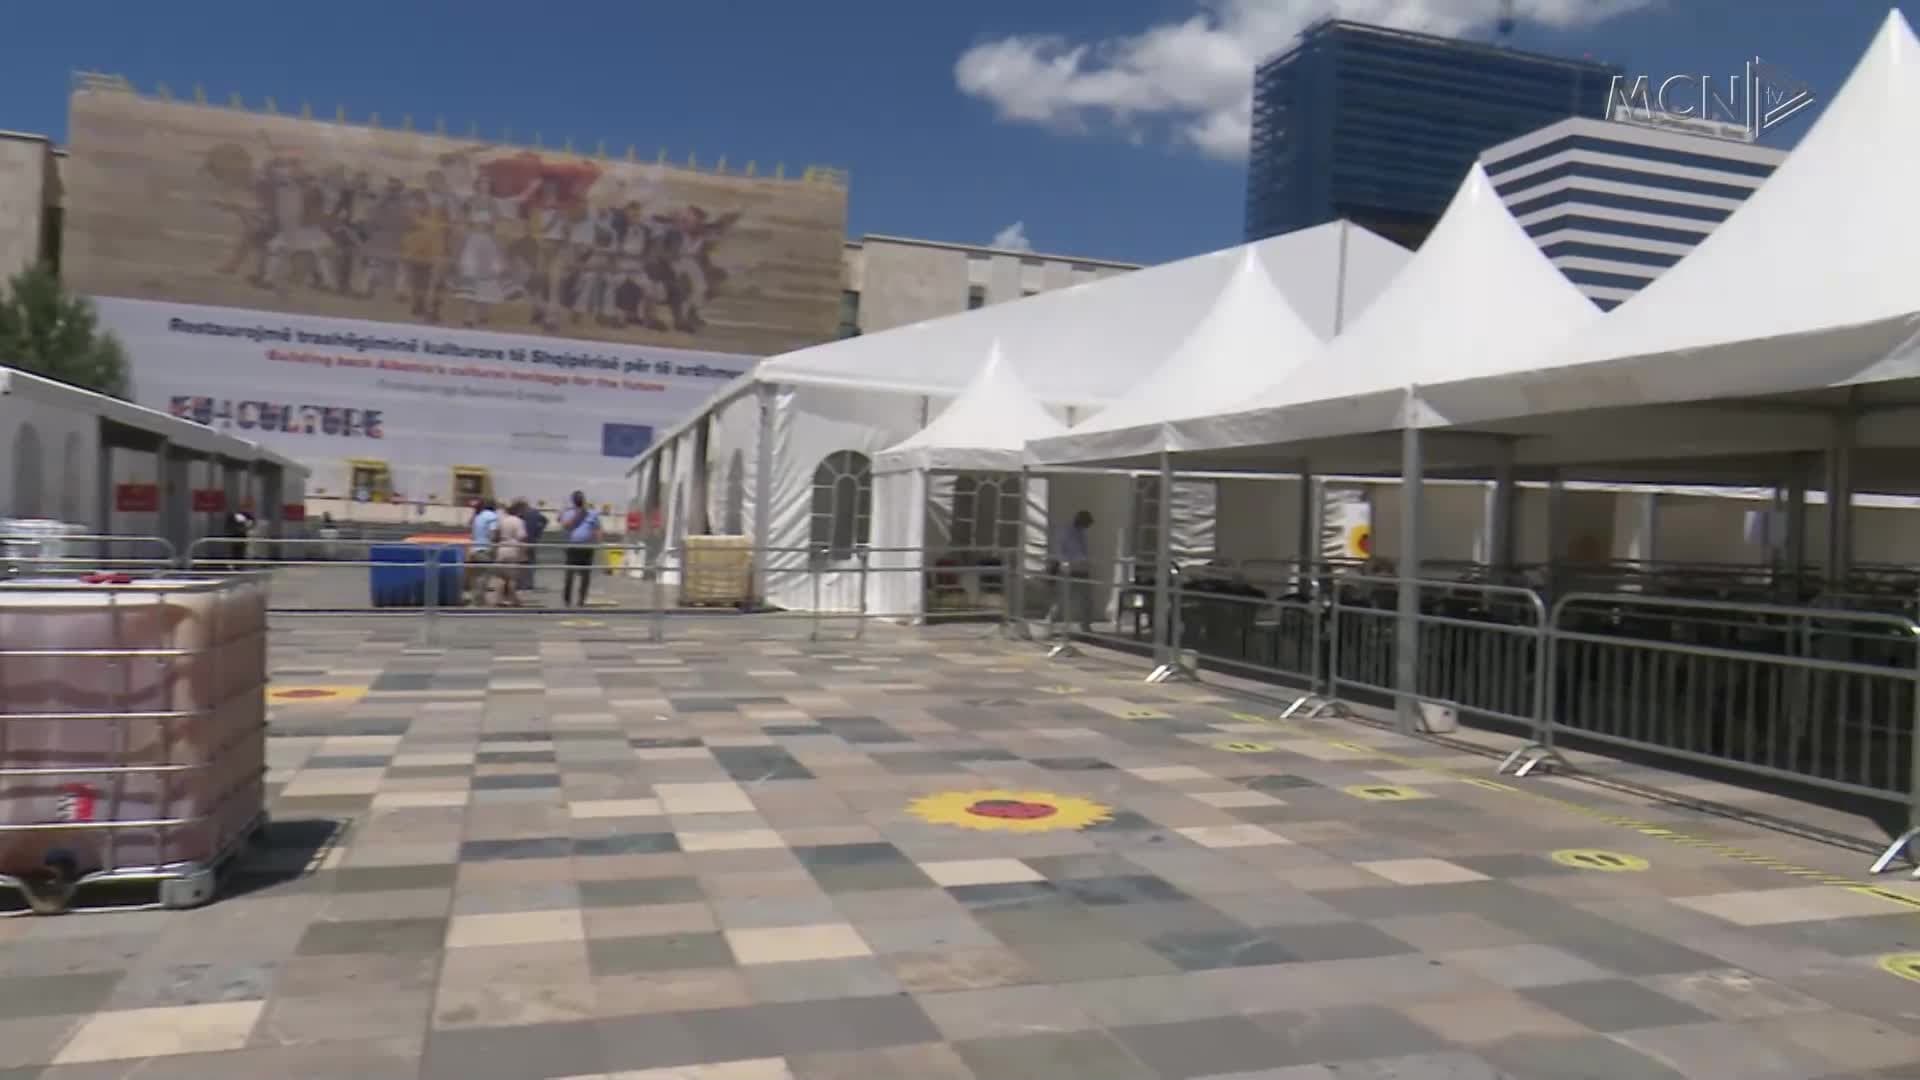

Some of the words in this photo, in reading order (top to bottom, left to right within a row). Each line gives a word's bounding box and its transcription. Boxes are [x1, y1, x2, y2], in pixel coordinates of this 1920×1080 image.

[168, 317, 291, 343] Restaurojmë
[296, 331, 418, 352] trashëgiminë
[509, 348, 526, 361] të
[531, 349, 618, 370] Shqipërisë
[623, 357, 650, 373] për
[655, 360, 671, 375] të
[266, 349, 333, 368] Building
[573, 374, 593, 385] for
[597, 376, 618, 388] the
[622, 378, 665, 392] future
